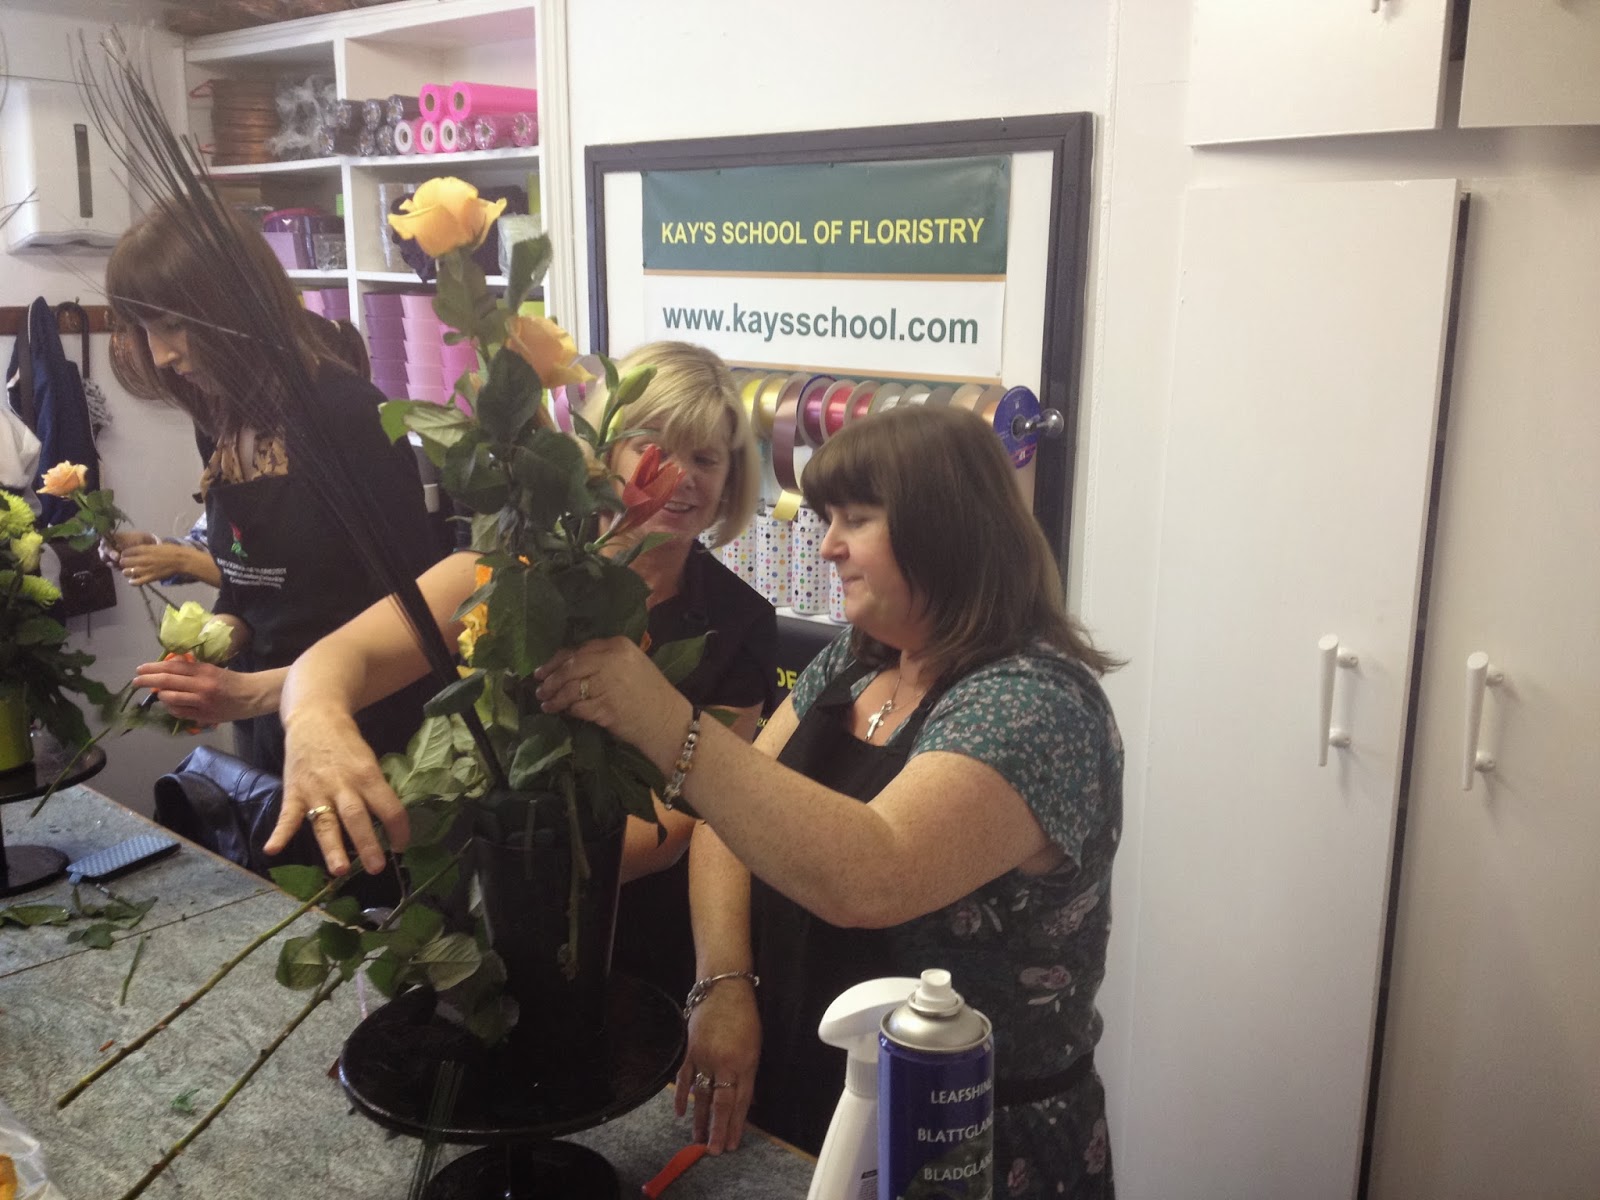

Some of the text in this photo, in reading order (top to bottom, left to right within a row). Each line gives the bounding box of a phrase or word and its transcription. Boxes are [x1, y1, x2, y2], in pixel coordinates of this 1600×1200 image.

[661, 218, 984, 245] KAY'S SCHOOL OF FLORISTRY
[663, 303, 978, 344] www.kaysschool.com
